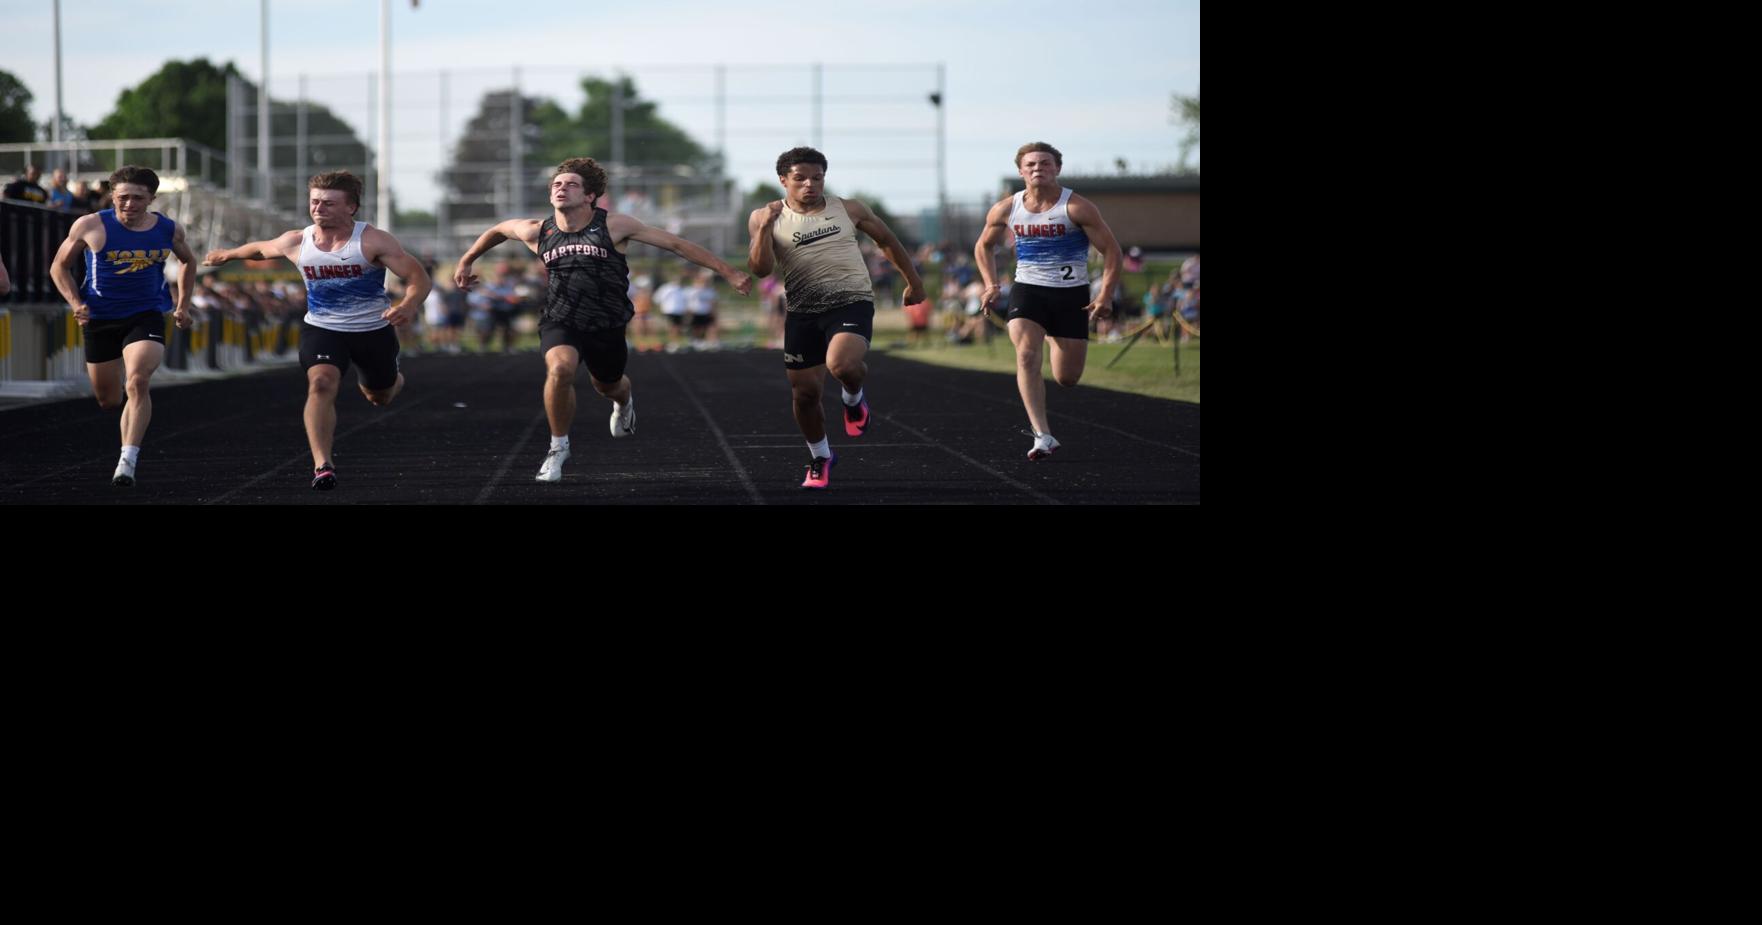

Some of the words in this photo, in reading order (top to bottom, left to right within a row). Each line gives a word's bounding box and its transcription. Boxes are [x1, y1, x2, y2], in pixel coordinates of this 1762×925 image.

[792, 225, 841, 246] Spartans
[543, 244, 608, 264] HARTFORD
[303, 264, 363, 280] SLINGER
[1060, 265, 1075, 280] 2
